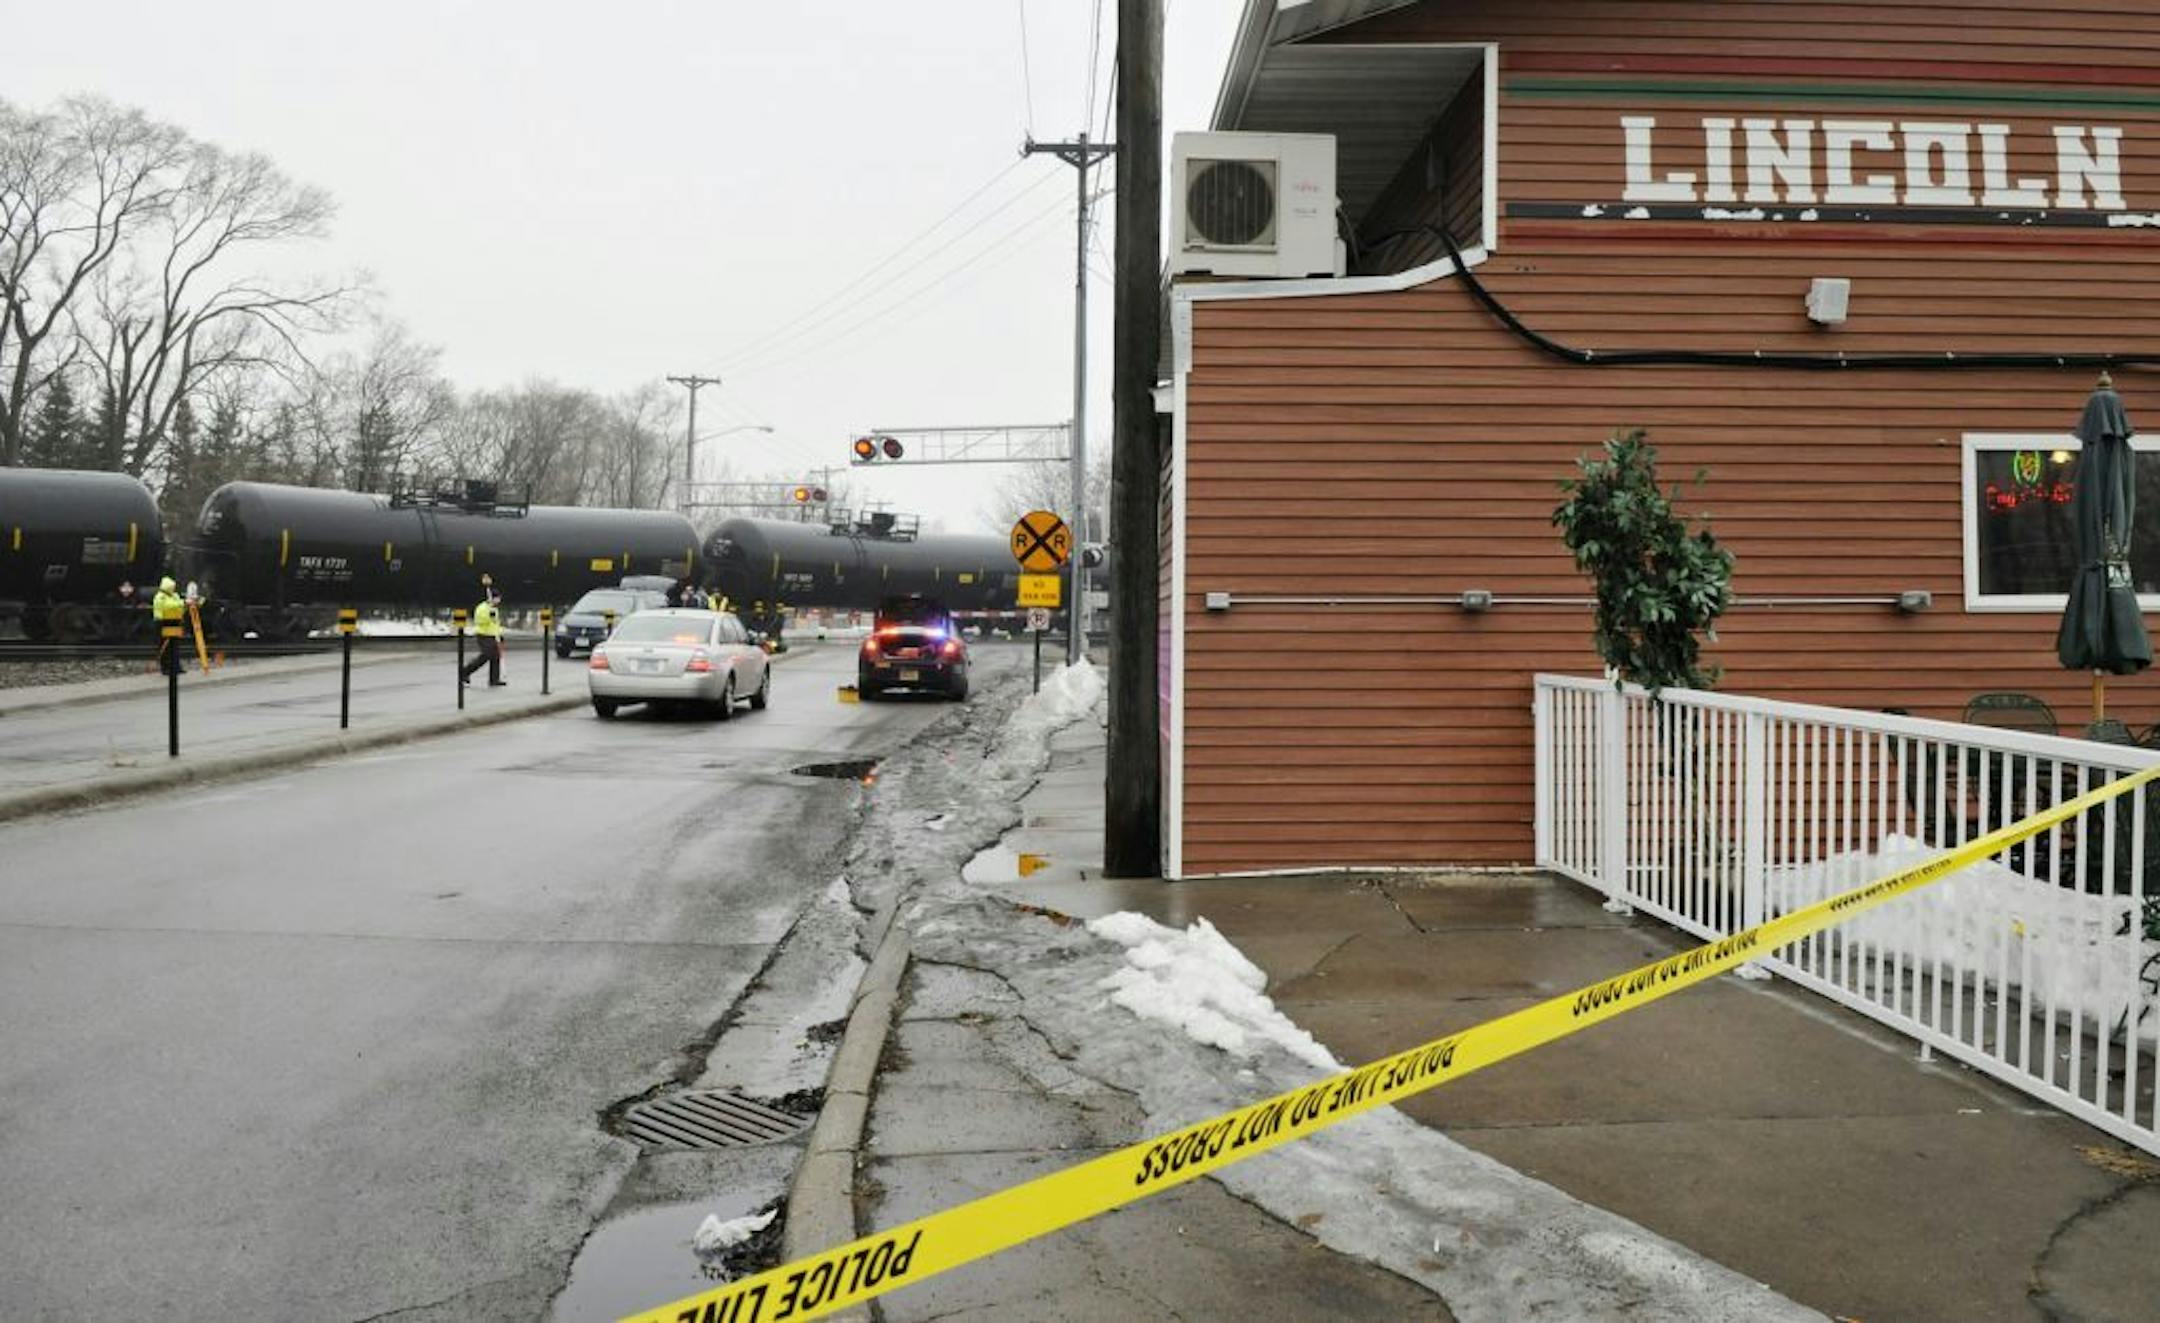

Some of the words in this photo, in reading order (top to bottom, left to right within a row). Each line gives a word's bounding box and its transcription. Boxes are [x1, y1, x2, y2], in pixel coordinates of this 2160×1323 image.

[1621, 116, 2127, 210] LINCOLN
[1016, 534, 1028, 548] R
[1054, 534, 1066, 548] R
[1328, 1064, 1387, 1112] LINE
[1383, 1041, 1457, 1092] POLICE
[1232, 1097, 1295, 1149] NOT
[1291, 1082, 1332, 1127] DO
[1136, 1118, 1235, 1186] CROSS
[775, 1229, 923, 1321] POLICE
